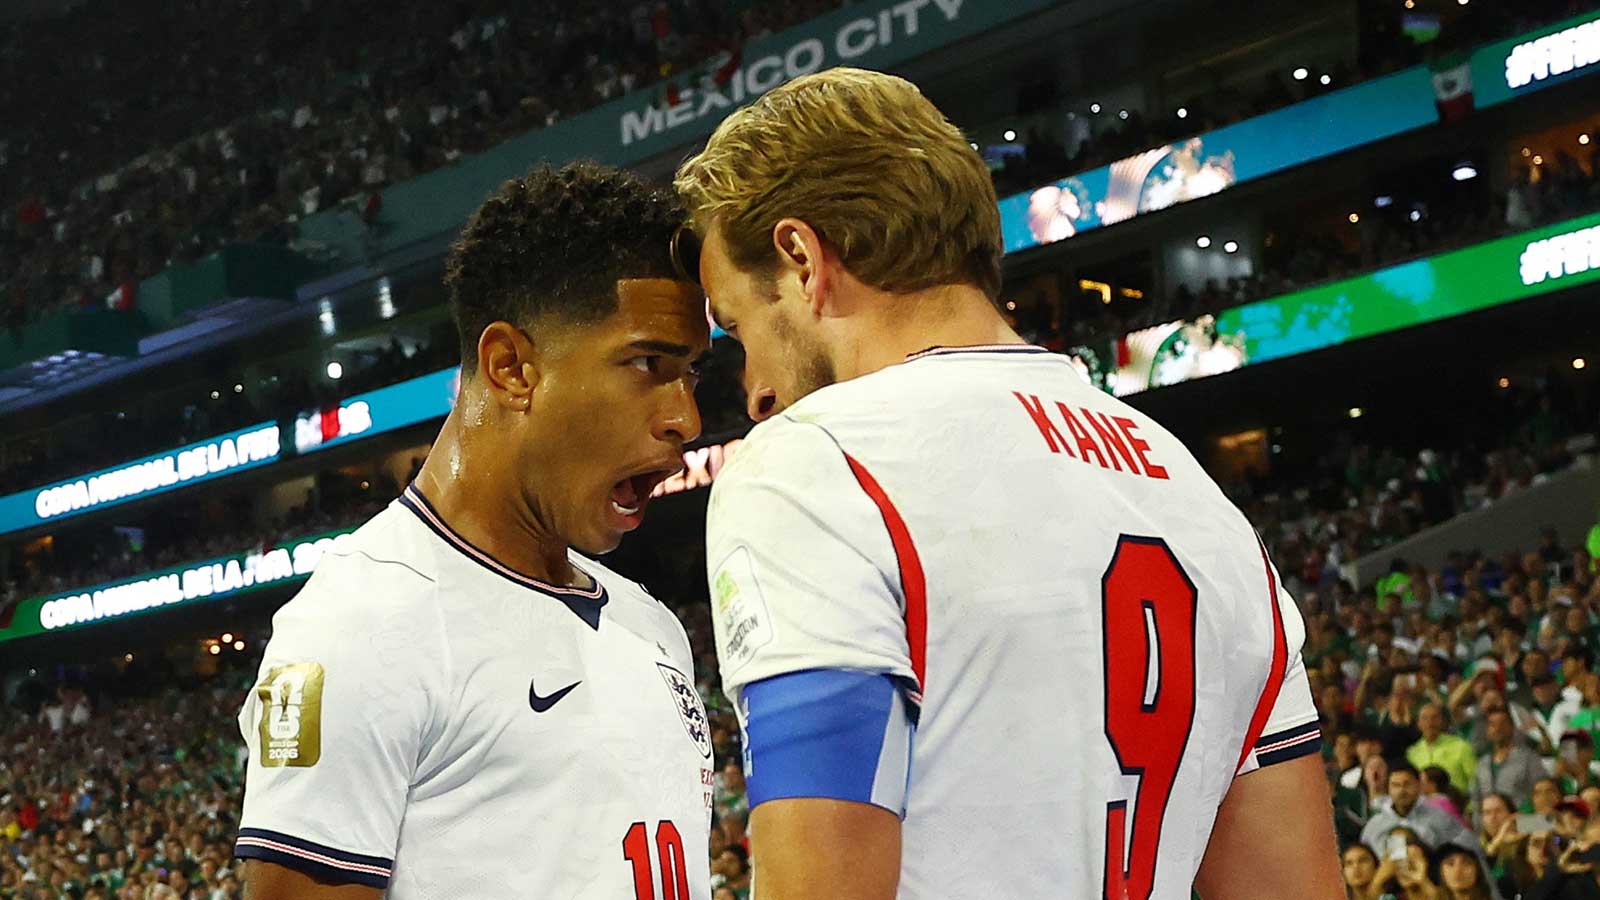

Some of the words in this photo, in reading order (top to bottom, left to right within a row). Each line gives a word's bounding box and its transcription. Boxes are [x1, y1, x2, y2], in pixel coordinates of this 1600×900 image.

[620, 38, 825, 146] MEXICO
[834, 0, 966, 60] CITY
[1012, 390, 1170, 480] KANE
[35, 480, 90, 518] COPA
[87, 455, 179, 505] MUNDIAL
[177, 445, 209, 481] DE
[207, 438, 239, 473] LA
[40, 593, 95, 629] COPA
[92, 573, 184, 619] MUNDIAL
[183, 565, 214, 599] DE
[212, 559, 245, 593] LA
[268, 748, 299, 760] 2026
[1101, 533, 1199, 900] 9
[622, 819, 691, 900] 10
